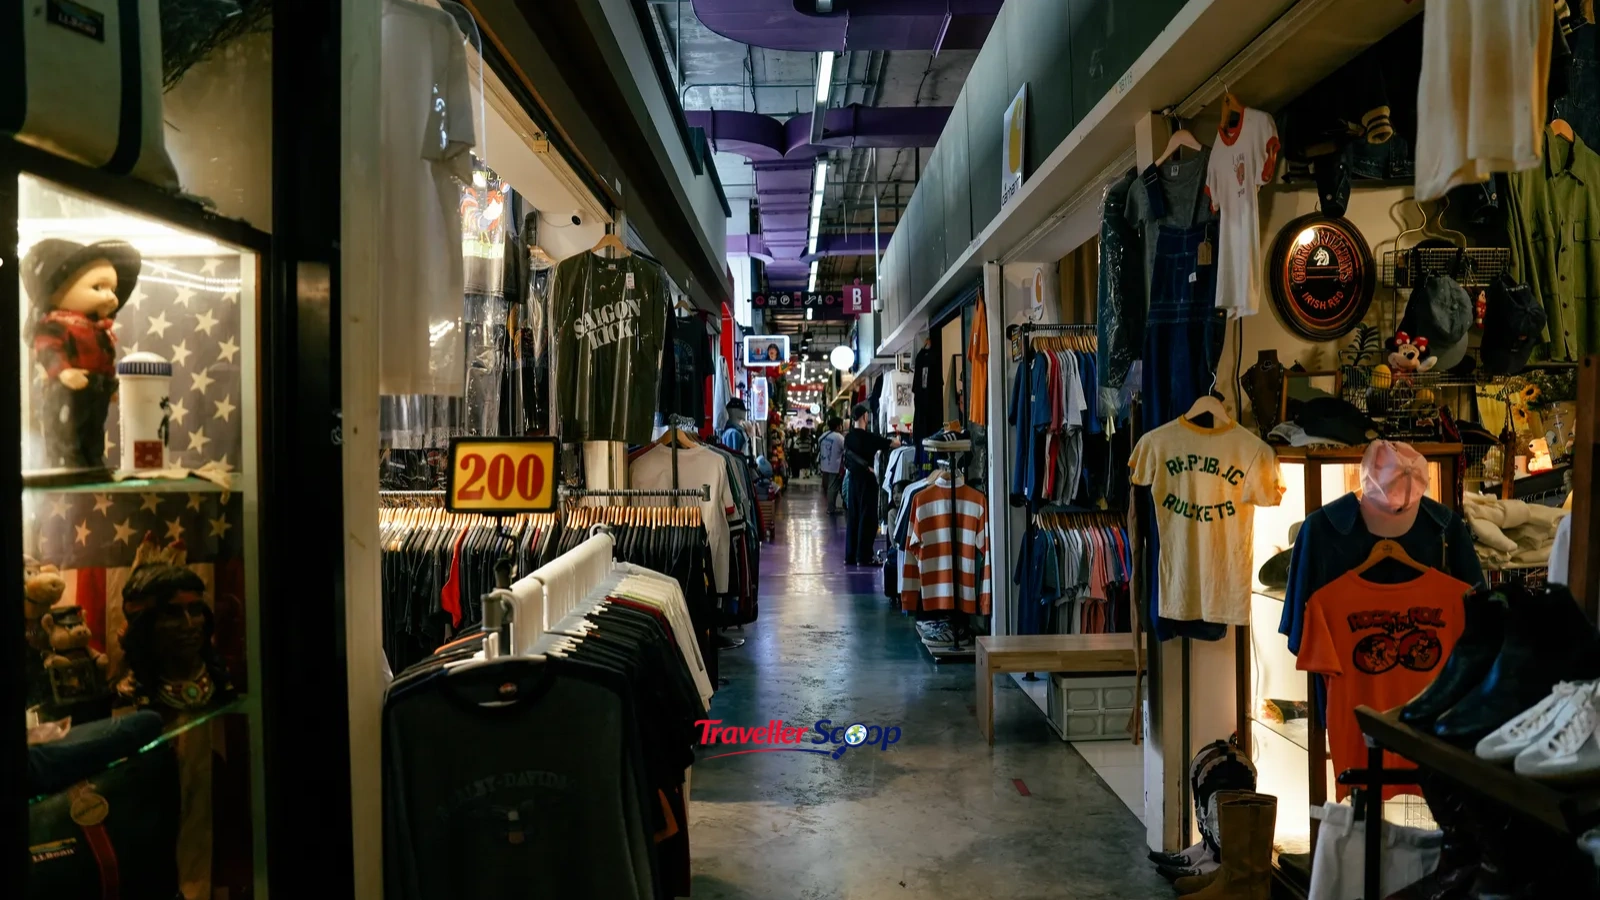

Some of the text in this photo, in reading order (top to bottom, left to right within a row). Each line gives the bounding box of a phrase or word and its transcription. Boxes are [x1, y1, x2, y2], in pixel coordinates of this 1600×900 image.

[852, 287, 862, 305] B
[1301, 290, 1345, 310] IRISH RED
[573, 298, 641, 340] SAIGON
[587, 318, 634, 350] KICK
[457, 453, 544, 501] 200
